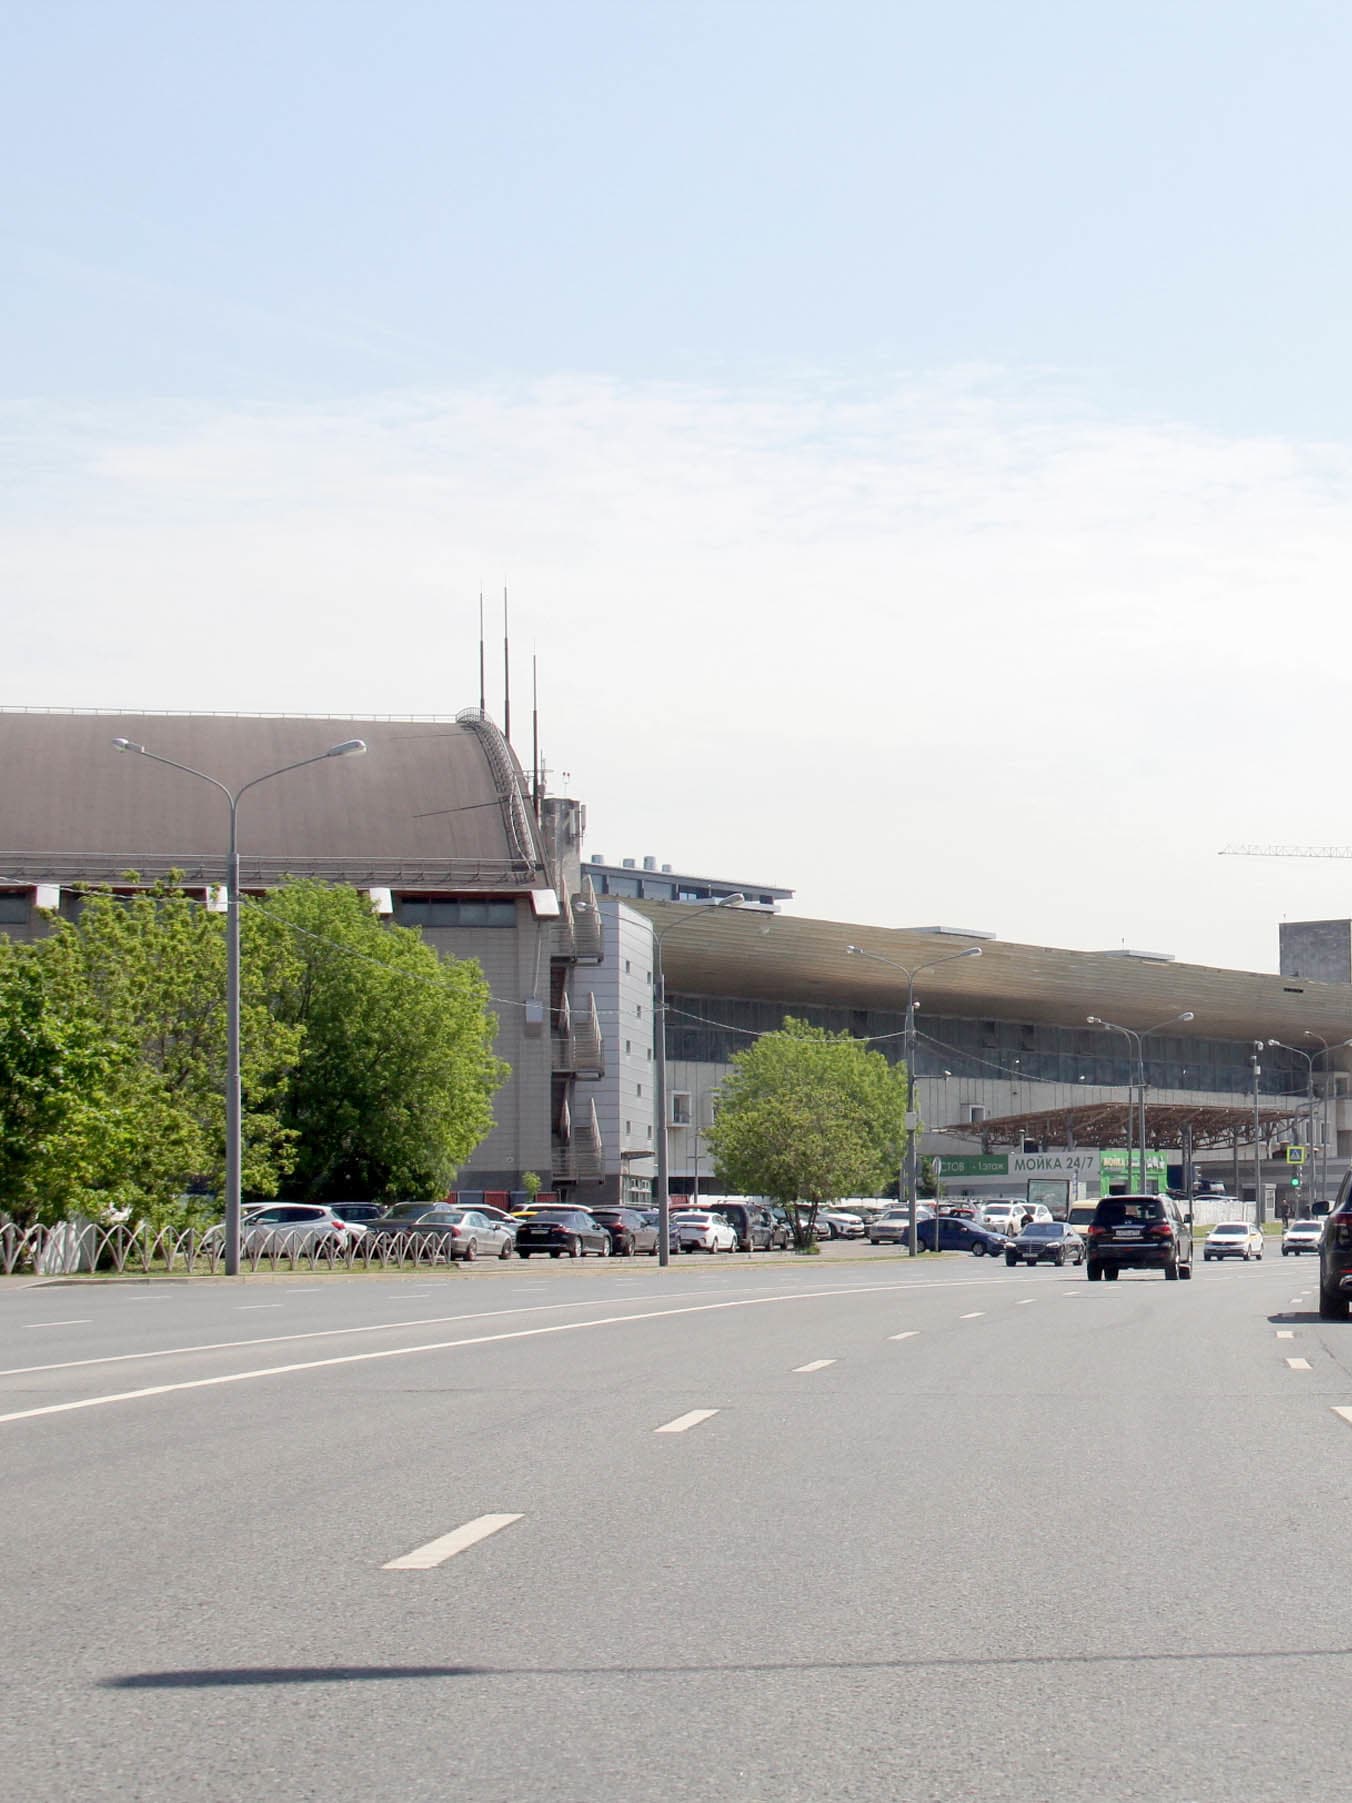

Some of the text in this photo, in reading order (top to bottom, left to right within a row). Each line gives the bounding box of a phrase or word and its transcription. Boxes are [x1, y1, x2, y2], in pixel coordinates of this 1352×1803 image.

[940, 1161, 965, 1172] СТОВ
[1014, 1156, 1094, 1171] МОЙКА 24/7
